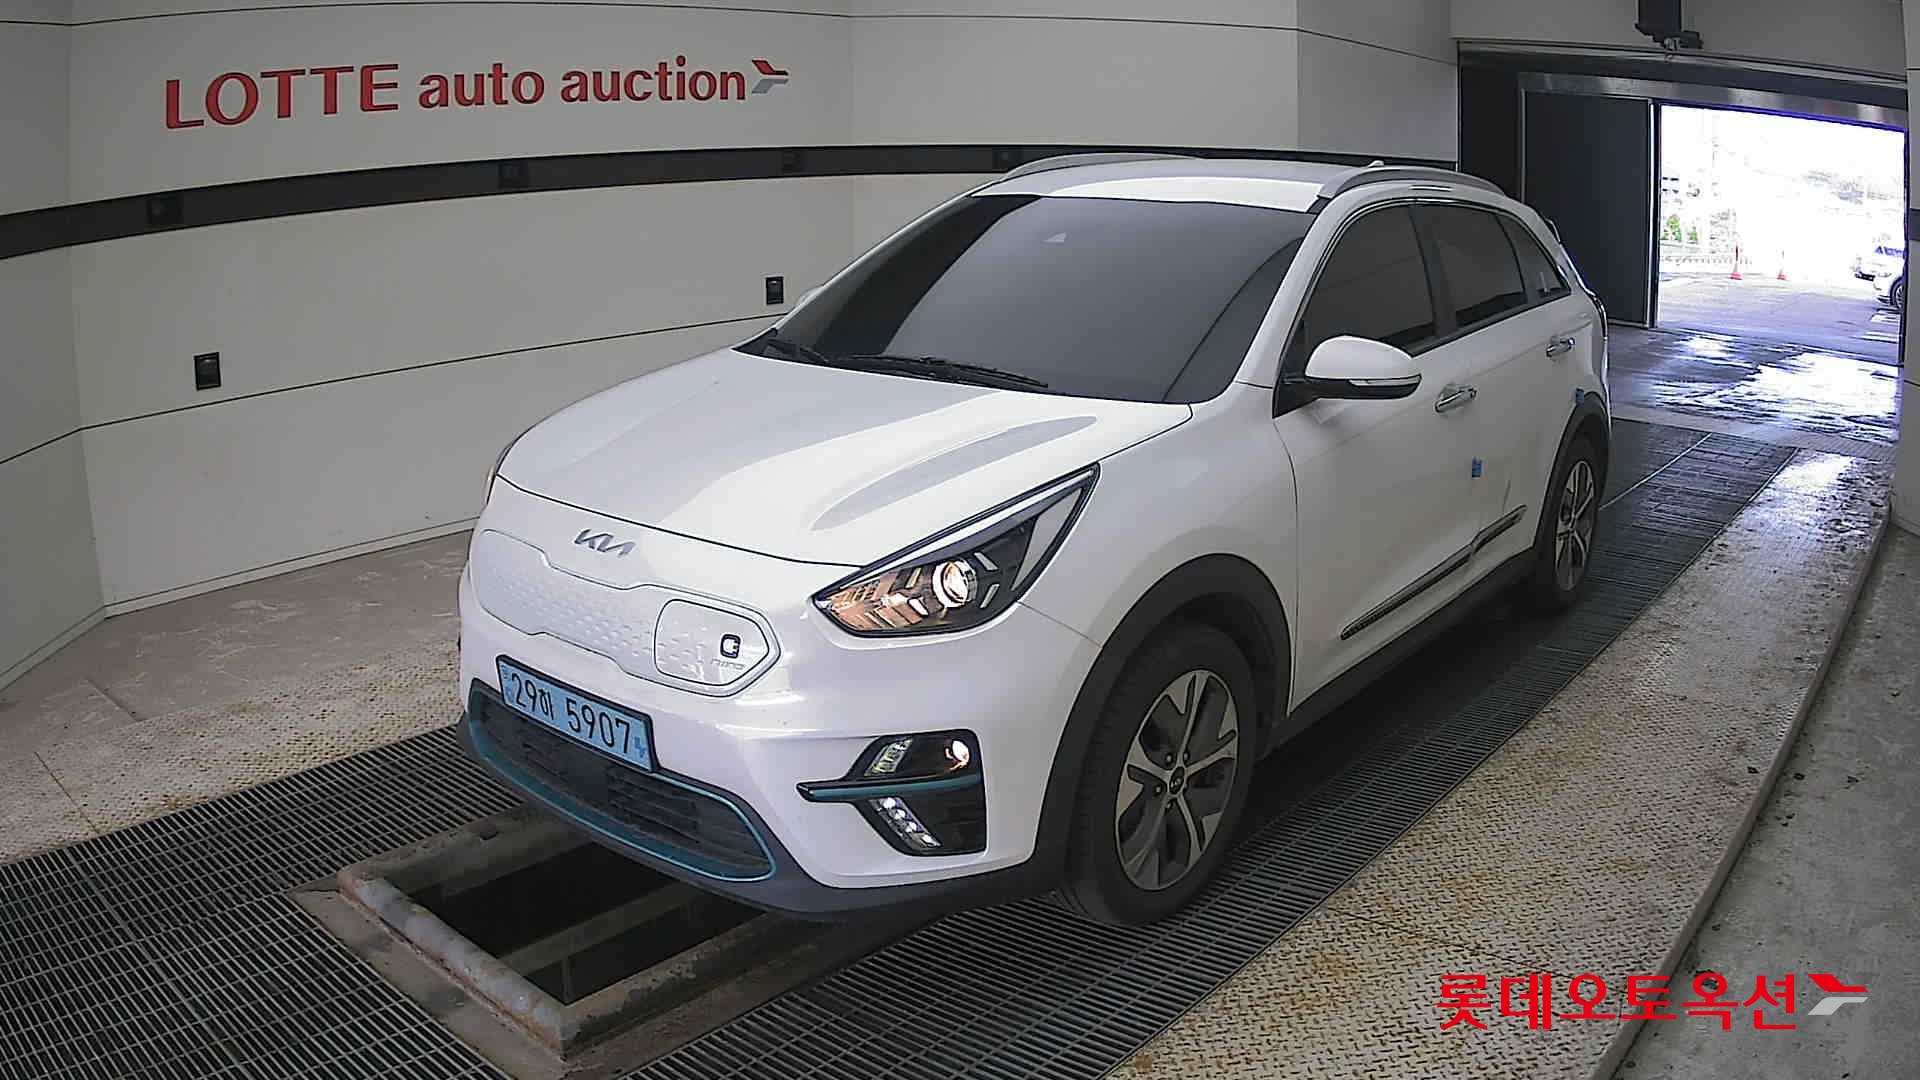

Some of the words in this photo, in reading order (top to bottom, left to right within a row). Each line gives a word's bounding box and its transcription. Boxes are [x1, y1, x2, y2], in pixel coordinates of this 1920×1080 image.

[165, 63, 399, 130] LOTTE
[418, 63, 545, 108] auto
[560, 55, 747, 102] auction
[574, 529, 636, 556] KIA
[565, 697, 630, 753] 5907
